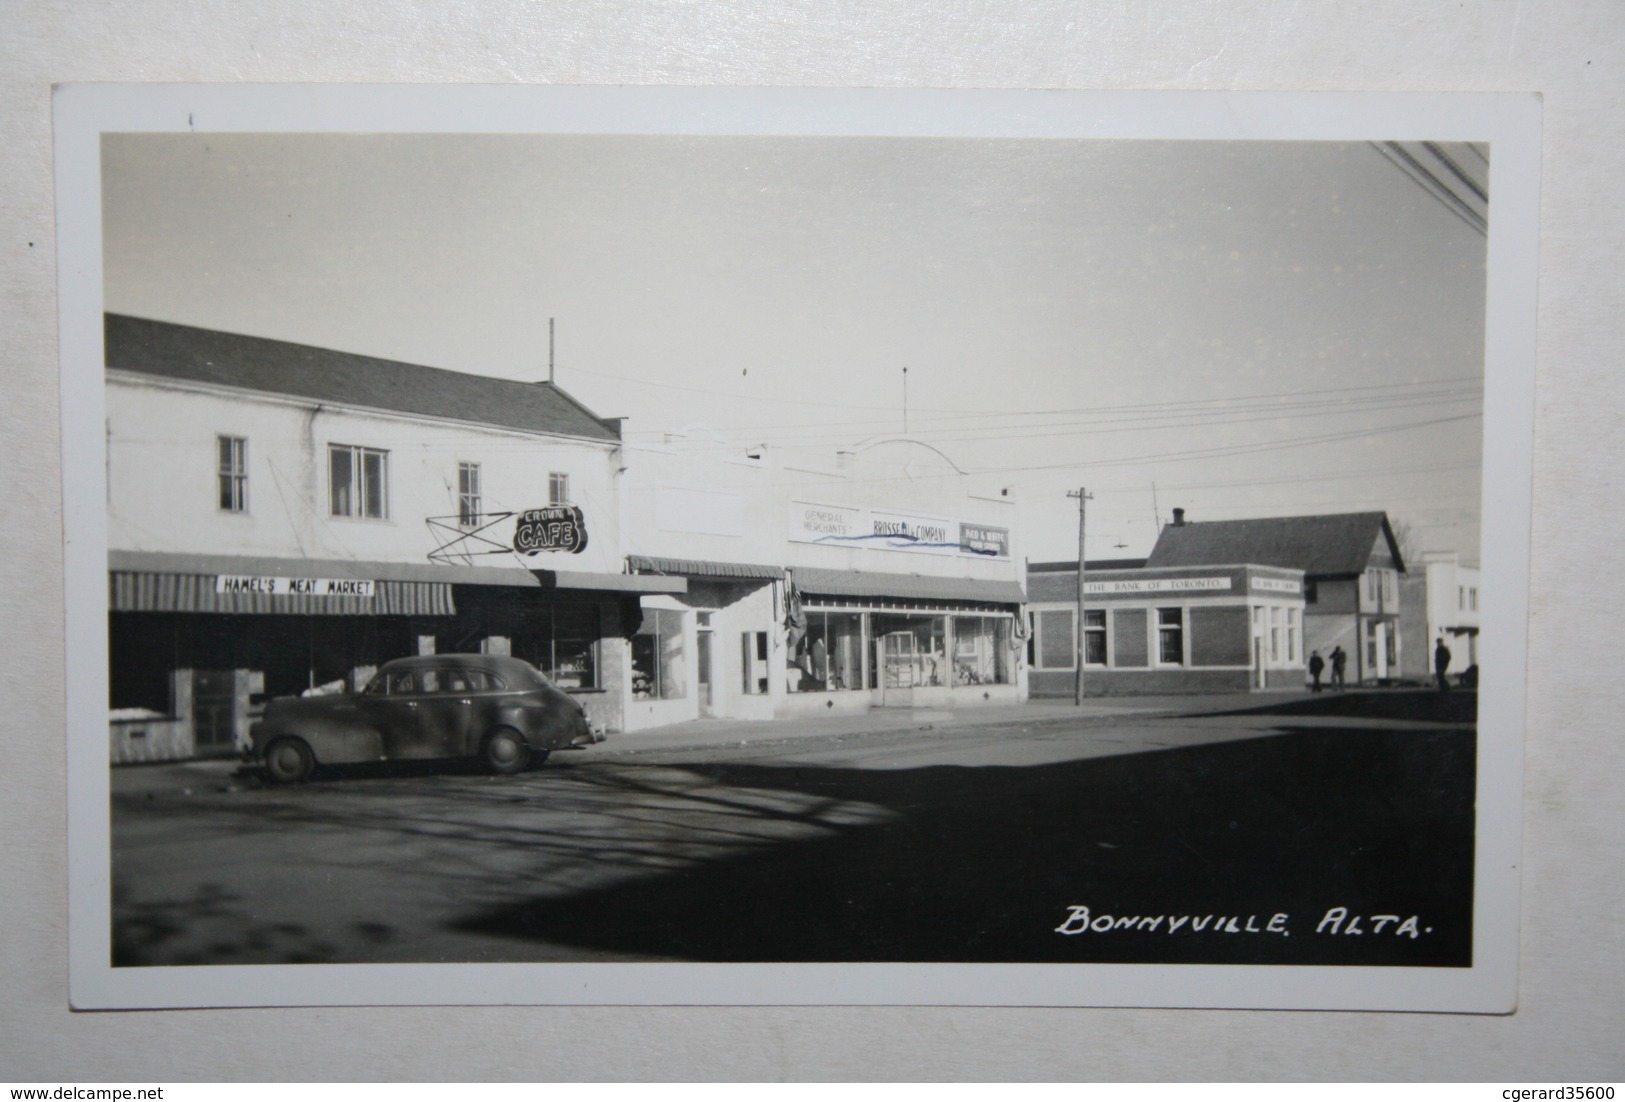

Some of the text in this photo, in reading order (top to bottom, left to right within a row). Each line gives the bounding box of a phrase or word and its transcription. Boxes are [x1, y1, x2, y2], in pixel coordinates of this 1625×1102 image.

[804, 510, 844, 524] GENERAL
[518, 522, 573, 547] CAFE
[803, 521, 847, 535] MERCHANTS
[916, 525, 946, 543] COMPANY
[965, 528, 979, 540] RED
[224, 576, 371, 595] HAMEL'S MEAT MARKET
[1088, 583, 1105, 592] THE
[1115, 581, 1141, 591] BANK
[1147, 580, 1161, 589] OF
[1316, 907, 1433, 939] ALTA.
